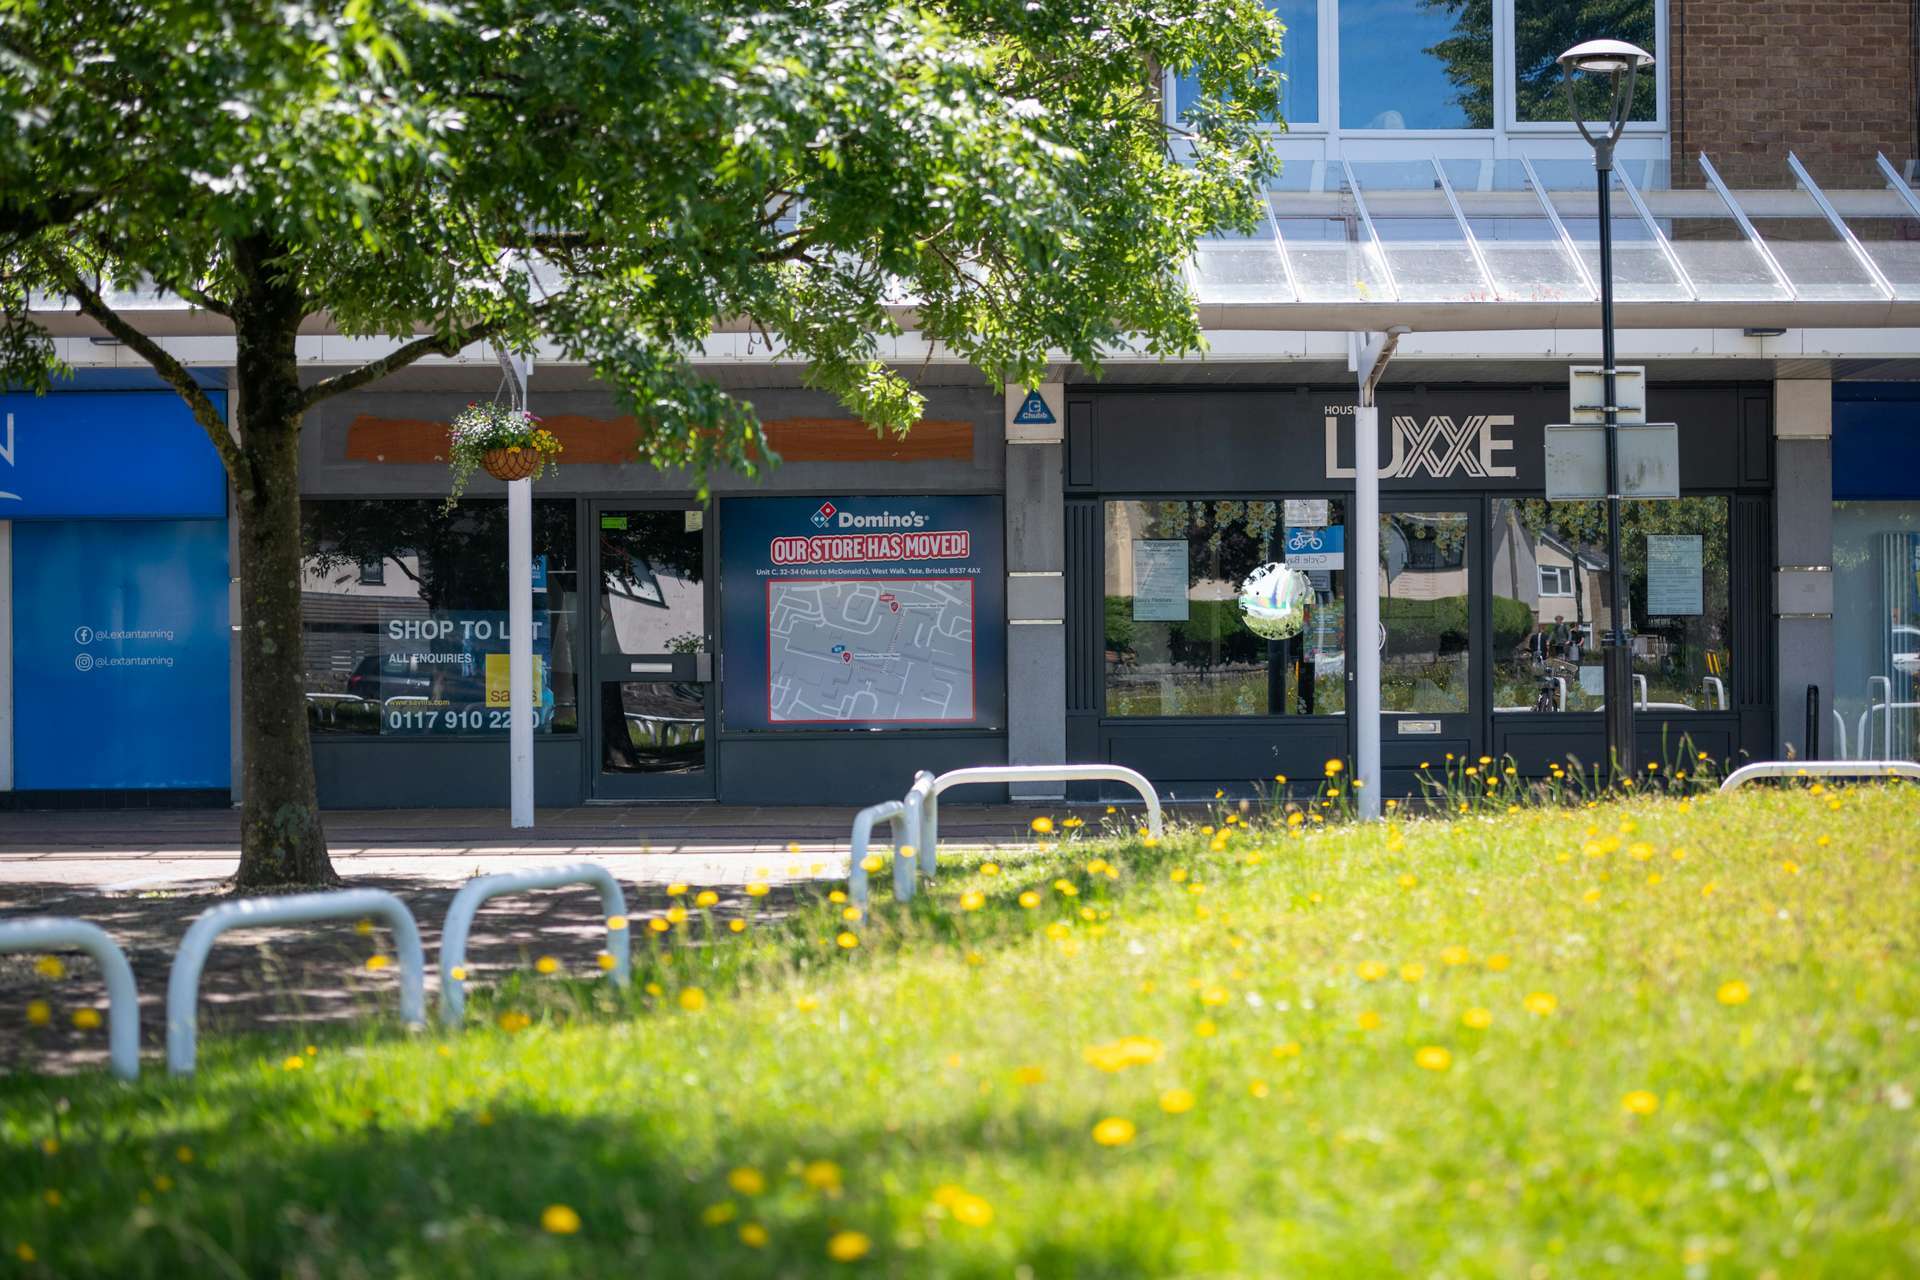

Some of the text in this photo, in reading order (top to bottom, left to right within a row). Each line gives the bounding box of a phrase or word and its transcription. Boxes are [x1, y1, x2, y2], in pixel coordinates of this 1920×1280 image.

[1325, 415, 1517, 479] LUXXE
[838, 511, 924, 528] Domino's
[774, 533, 967, 561] OUR STORE HAS MOVED!
[756, 568, 770, 576] Unit
[780, 568, 799, 576] 32-34
[800, 568, 819, 577] (Next
[820, 568, 827, 576] to
[872, 568, 888, 576] West
[949, 567, 966, 575] BS37
[967, 567, 981, 575] 4AX
[95, 628, 174, 641] @Lextantanning
[388, 619, 543, 640] SHOP TO LT
[95, 655, 174, 668] @Lextantanning
[388, 653, 410, 664] ALL
[389, 710, 540, 729] 0117 910 220
